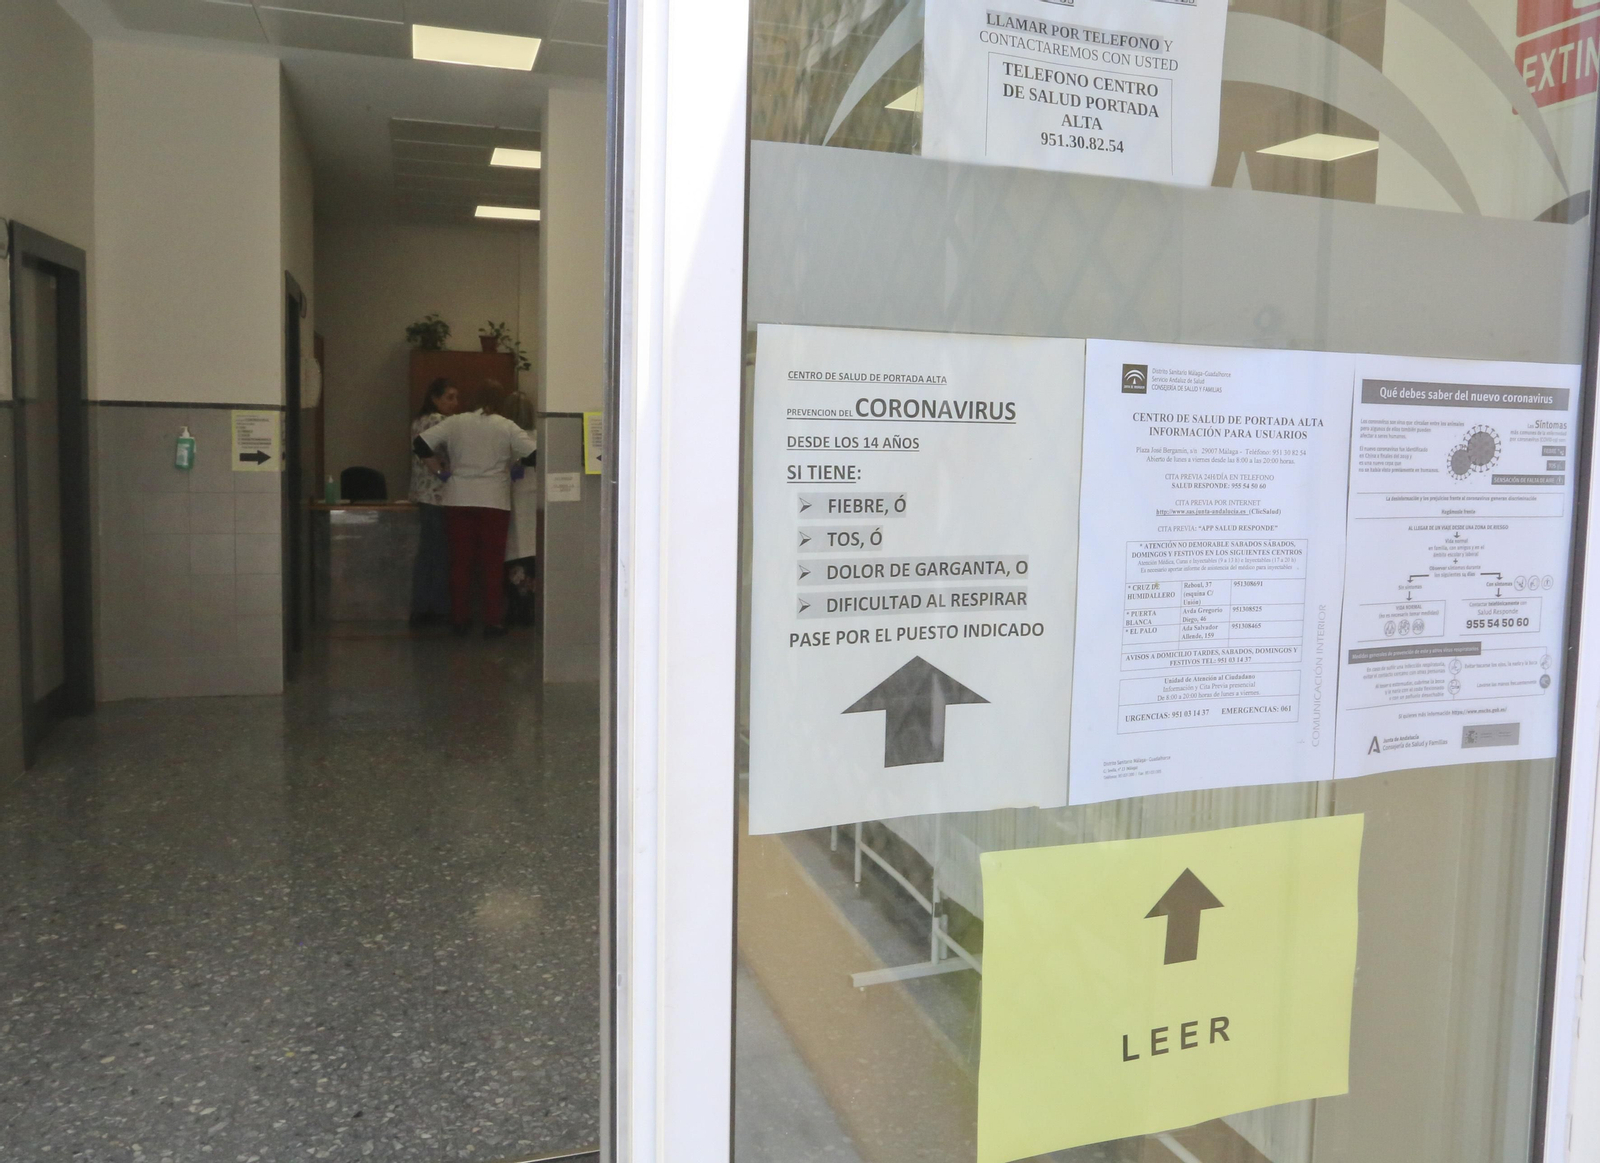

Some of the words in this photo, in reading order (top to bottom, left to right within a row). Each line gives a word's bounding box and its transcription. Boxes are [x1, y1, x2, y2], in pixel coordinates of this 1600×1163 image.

[986, 12, 1048, 36] LLAMAR
[1051, 24, 1080, 40] POR
[1082, 29, 1160, 51] TELEFONO
[1163, 40, 1174, 53] Y
[979, 30, 1098, 61] CONTACTAREMOS
[1101, 50, 1130, 65] CON
[1134, 54, 1178, 71] USTED
[1002, 61, 1088, 87] TELEFONO
[1093, 76, 1158, 97] CENTRO
[1002, 82, 1024, 99] DE
[1029, 87, 1081, 107] SALUD
[1085, 95, 1159, 118] PORTADA
[1061, 113, 1103, 130] ALTA
[1040, 131, 1124, 153] 951.30.82.54
[787, 370, 824, 382] CENTRO
[823, 371, 838, 382] DE
[837, 372, 869, 383] SALUD
[868, 373, 882, 383] DE
[881, 373, 925, 384] PORTADA
[924, 375, 947, 385] ALTA
[1379, 386, 1397, 399] Qué
[1399, 387, 1425, 399] debes
[1427, 388, 1453, 400] saber
[1454, 389, 1468, 400] del
[1470, 393, 1500, 402] nuevo
[1502, 392, 1553, 403] coronavirus
[786, 407, 837, 417] PREVENCION
[838, 408, 853, 417] DEL
[855, 397, 1016, 421] CORONAVIRUS
[1132, 412, 1174, 422] CENTRO
[1176, 413, 1189, 423] DE
[1192, 414, 1225, 424] SALUD
[1227, 415, 1241, 424] DE
[1244, 415, 1294, 426] PORTADA
[1297, 417, 1323, 426] ALTA
[1534, 420, 1567, 429] Síntomas
[1149, 426, 1221, 437] INFORMACIÓN
[1224, 428, 1251, 438] PARA
[1255, 429, 1307, 439] USUARIOS
[787, 435, 830, 450] DESDE
[834, 436, 859, 450] LOS
[863, 436, 879, 450] 14
[882, 433, 920, 450] AÑOS
[787, 464, 801, 479] SI
[806, 464, 861, 481] TIENE:
[1164, 472, 1179, 480] CITA
[1239, 473, 1274, 481] TELEFONO
[828, 498, 888, 515] FIEBRE,
[893, 494, 906, 512] Ó
[1247, 507, 1281, 515] (ClicSalud)
[826, 531, 864, 548] TOS,
[869, 527, 882, 545] Ó
[1143, 541, 1176, 549] ATENCIÓN
[1131, 550, 1167, 558] DOMINGOS
[827, 563, 884, 579] DOLOR
[889, 562, 910, 577] DE
[914, 560, 1010, 577] GARGANTA,
[1015, 560, 1028, 574] O
[1132, 583, 1150, 591] CRUZ
[826, 594, 921, 612] DIFICULTAD
[925, 593, 946, 608] AL
[950, 591, 1027, 607] RESPIRAR
[1197, 606, 1222, 614] Gregorio
[1125, 618, 1152, 626] BLANCA
[1182, 616, 1199, 624] Diego,
[1199, 615, 1208, 623] 46
[1465, 619, 1485, 629] 955
[1487, 618, 1499, 628] 54
[1501, 617, 1514, 627] 50
[1516, 617, 1529, 626] 60
[789, 631, 830, 647] PASE
[836, 628, 870, 645] POR
[875, 627, 892, 642] EL
[896, 624, 958, 641] PUESTO
[963, 622, 1044, 637] INDICADO
[1139, 626, 1157, 634] PALO
[1181, 632, 1203, 640] Allende,
[1203, 632, 1214, 640] 159
[1315, 604, 1327, 654] INTERIOR
[1125, 653, 1149, 661] AVISOS
[1156, 651, 1192, 660] DOMICILIO
[1193, 650, 1220, 659] TARDES,
[1221, 648, 1253, 658] SABADOS,
[1169, 658, 1201, 667] FESTIVOS
[1216, 657, 1226, 665] 951
[1227, 656, 1236, 664] 03
[1235, 656, 1244, 664] 14
[1243, 656, 1251, 664] 37
[1311, 656, 1324, 748] COMUNICACIÓN
[1125, 711, 1170, 722] URGENCIAS:
[1171, 710, 1182, 718] 951
[1201, 708, 1209, 716] 37
[1221, 705, 1279, 714] EMERGENCIAS:
[1382, 742, 1404, 751] Consejería
[1122, 1016, 1230, 1062] LEER
